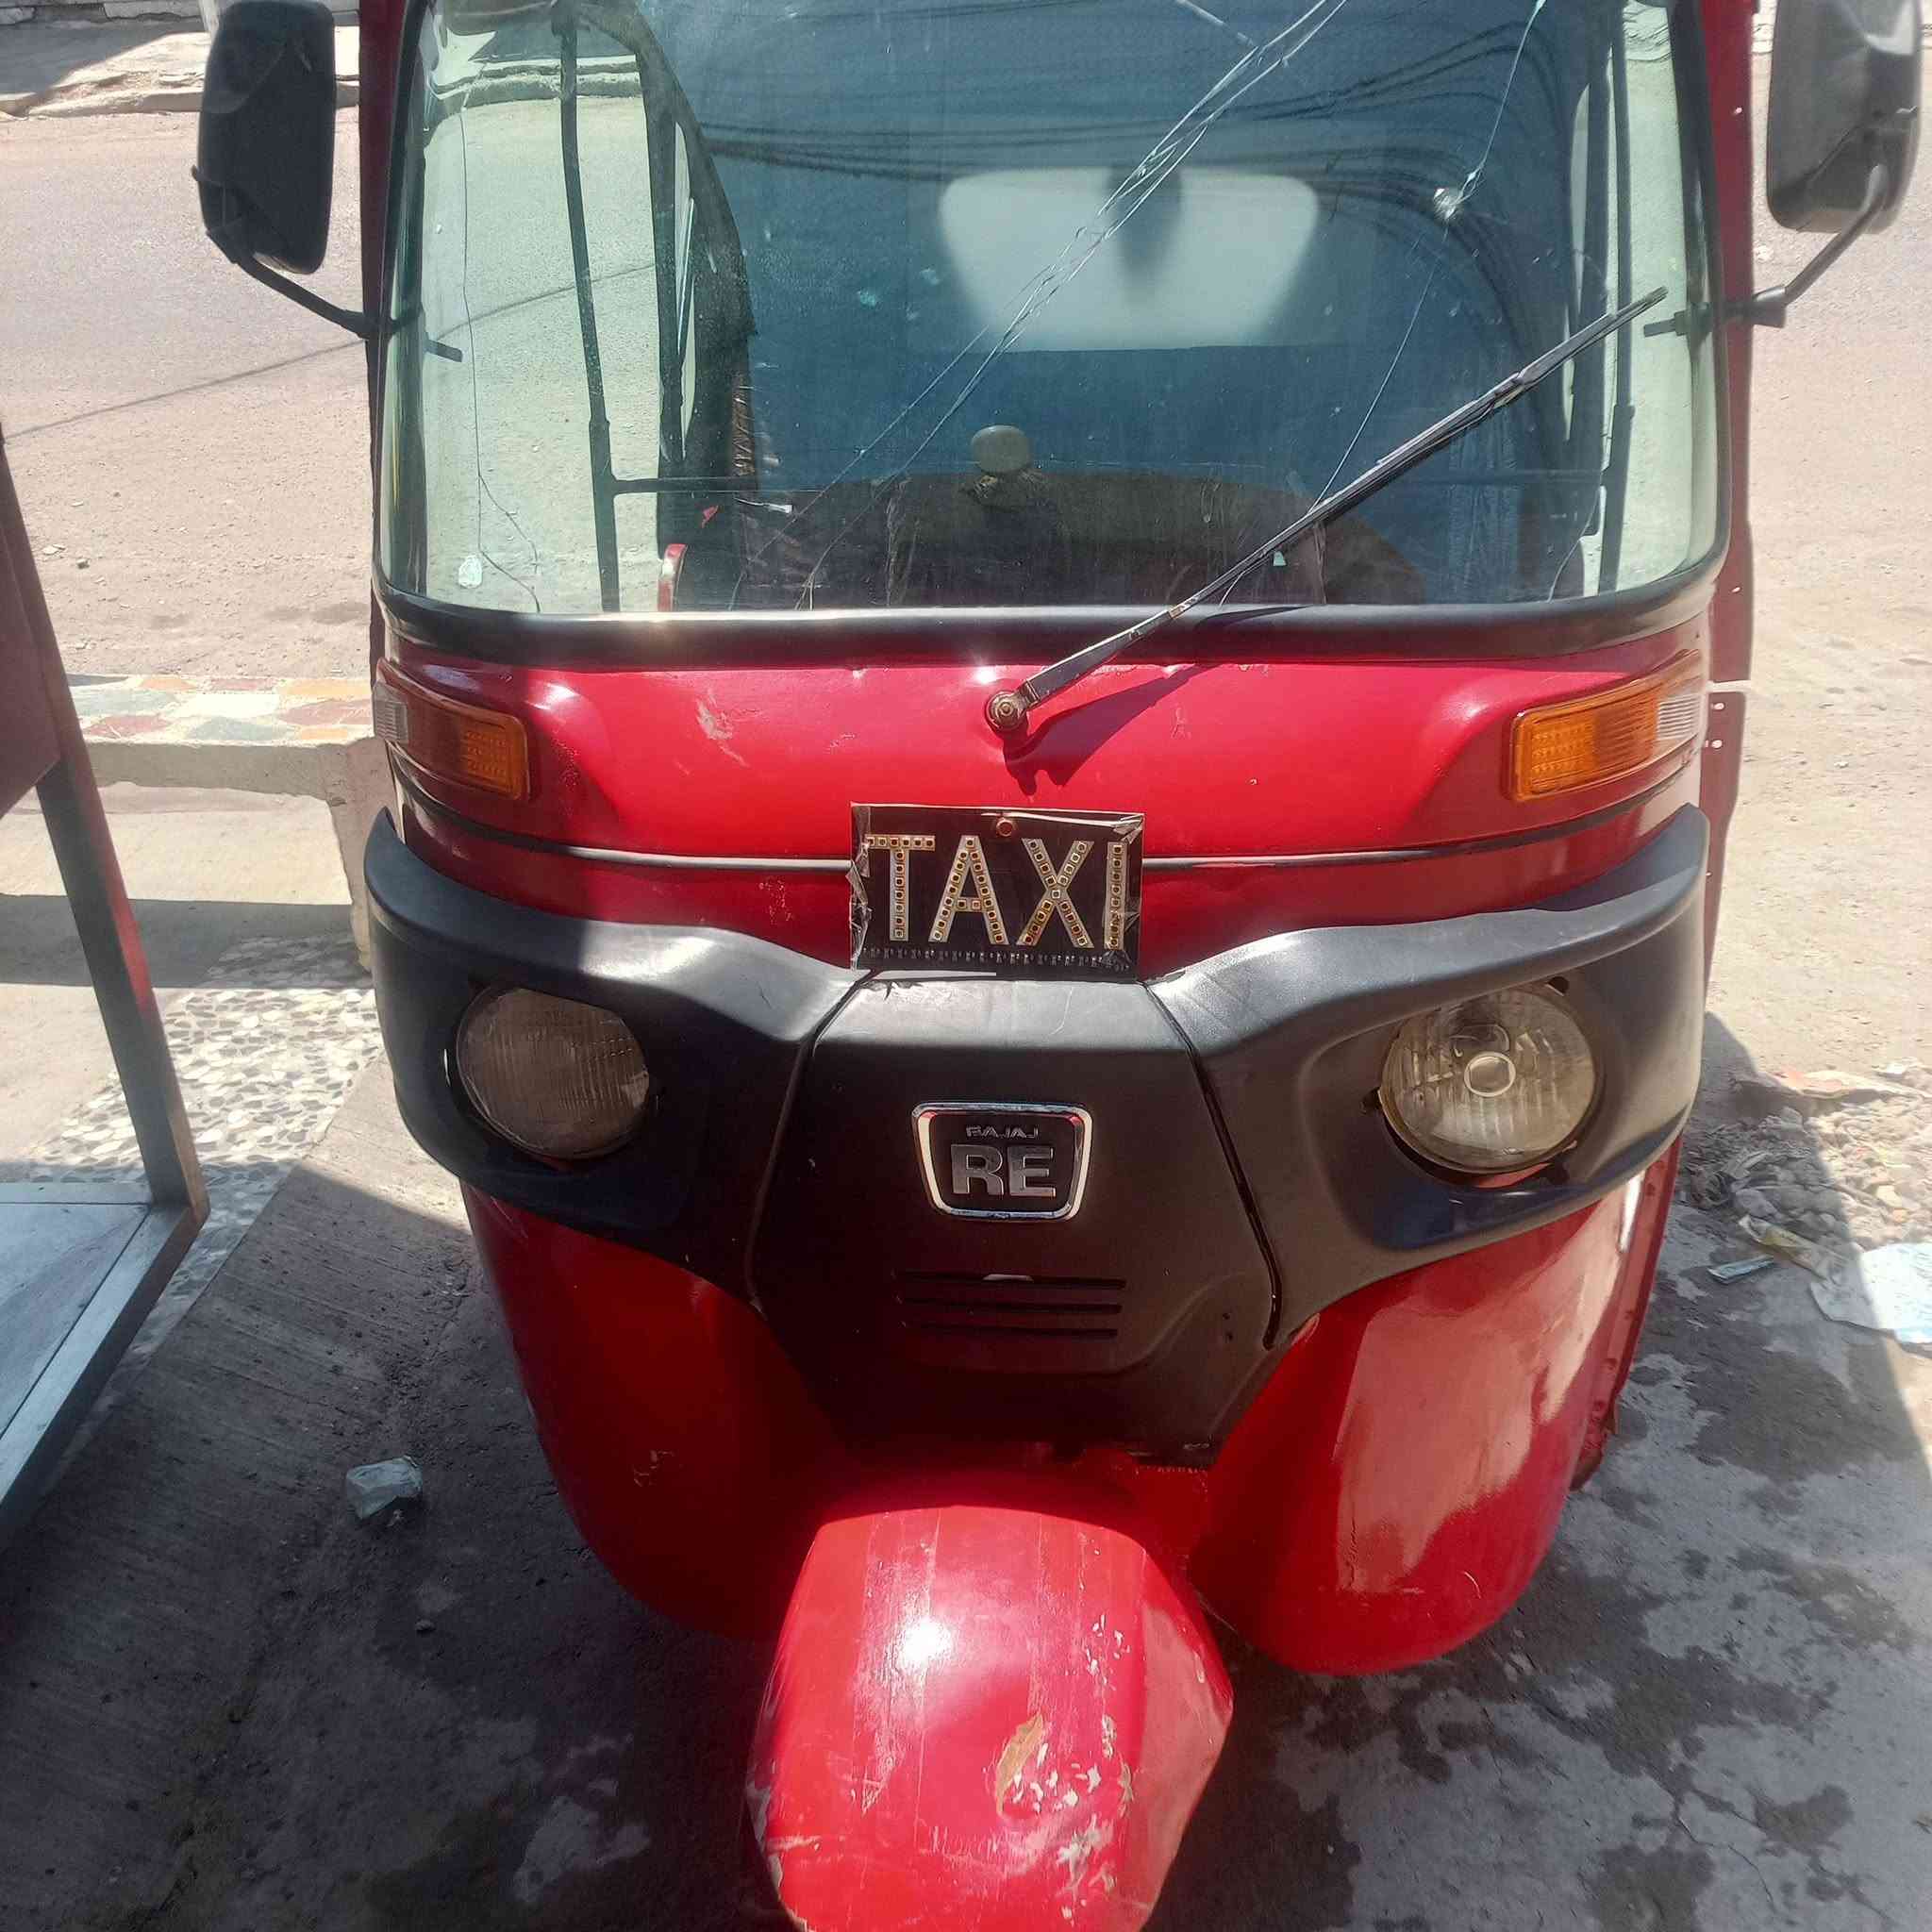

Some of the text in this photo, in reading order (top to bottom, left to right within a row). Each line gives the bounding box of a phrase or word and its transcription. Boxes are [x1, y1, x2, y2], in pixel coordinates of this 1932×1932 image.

[865, 834, 1126, 950] TAXI
[966, 1125, 1039, 1139] BAJAJ
[950, 1143, 1057, 1197] RE
